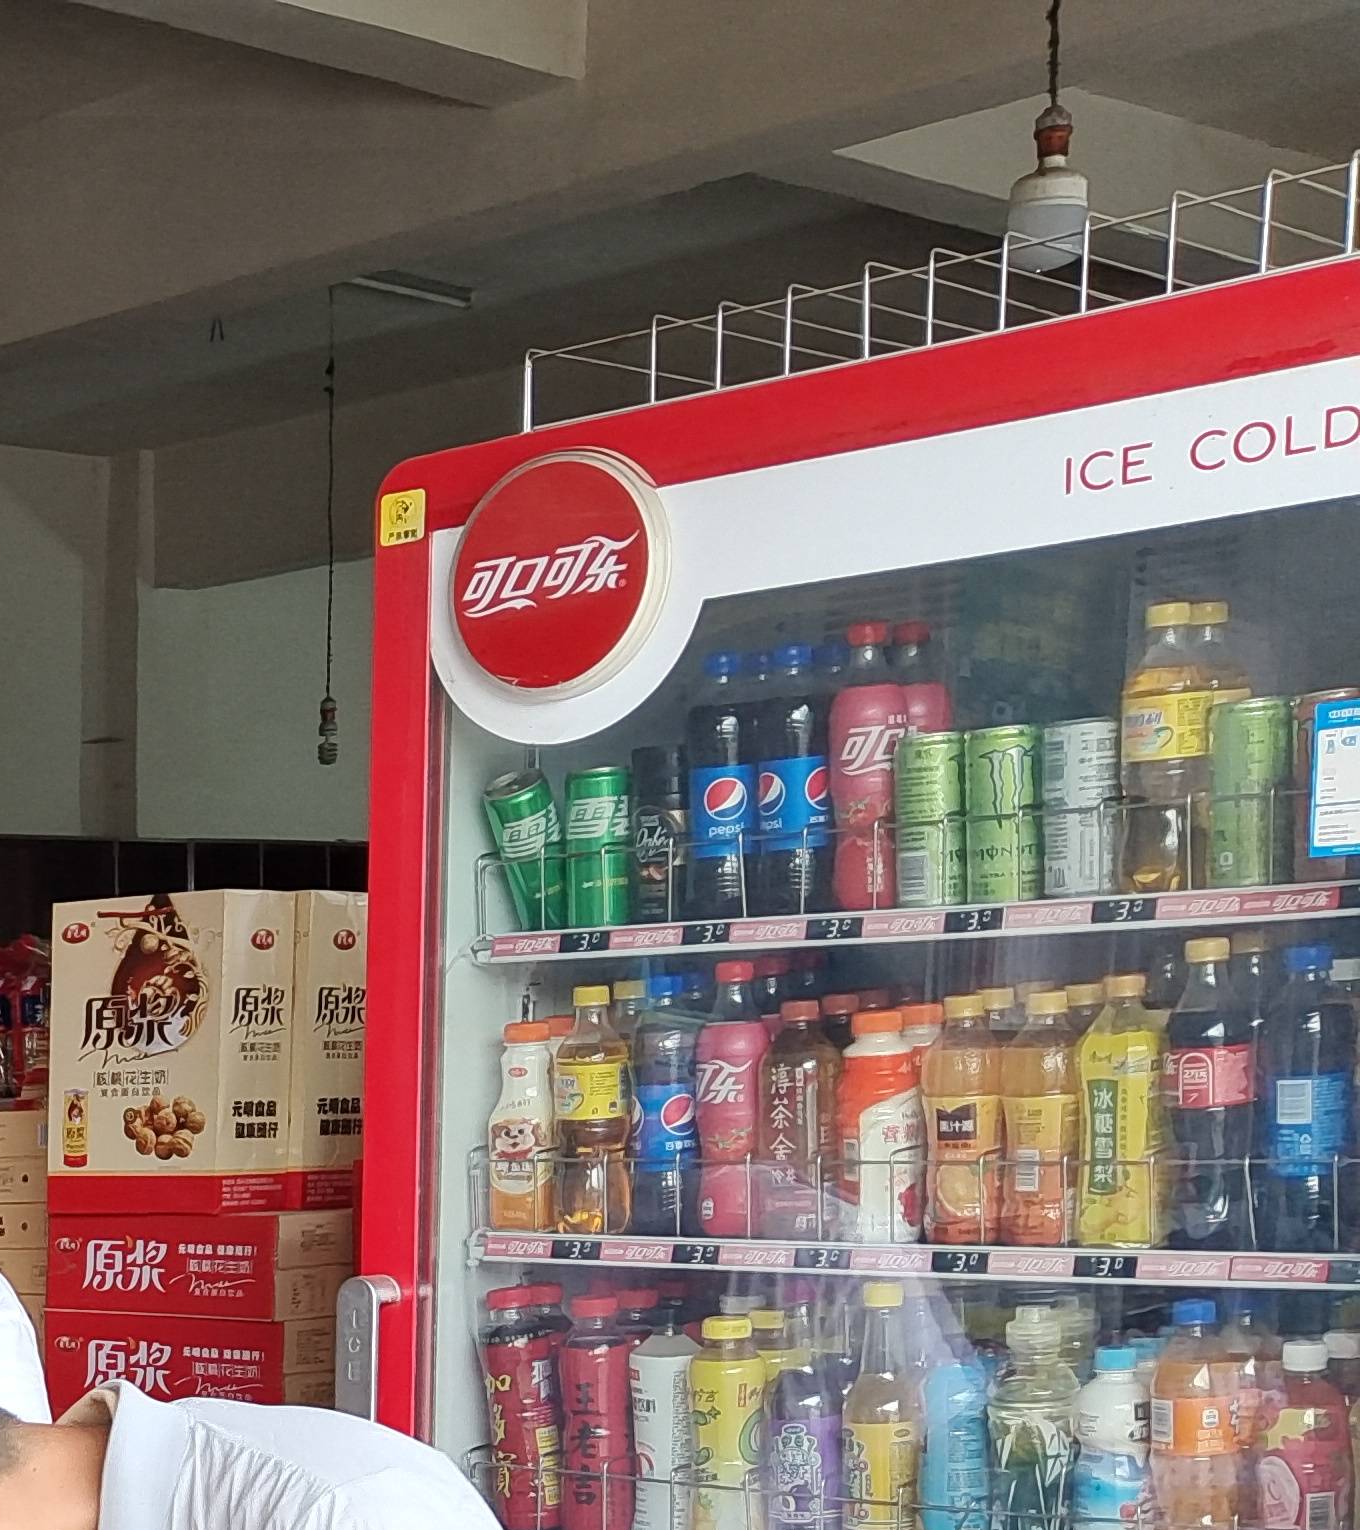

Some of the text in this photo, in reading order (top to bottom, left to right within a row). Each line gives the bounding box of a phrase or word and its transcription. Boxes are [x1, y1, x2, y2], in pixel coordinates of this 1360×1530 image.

[1063, 402, 1360, 496] ICE COLD
[462, 530, 640, 618] 可口可乐
[81, 995, 175, 1050] 原浆
[231, 984, 285, 1027] 原浆
[315, 984, 365, 1027] 原浆
[93, 1069, 169, 1087] 核桃花生奶
[769, 1063, 797, 1161] 淳茶舍
[1092, 1087, 1114, 1184] 冰糖雪梨
[82, 1236, 169, 1293] 原浆
[84, 1338, 172, 1395] 原浆
